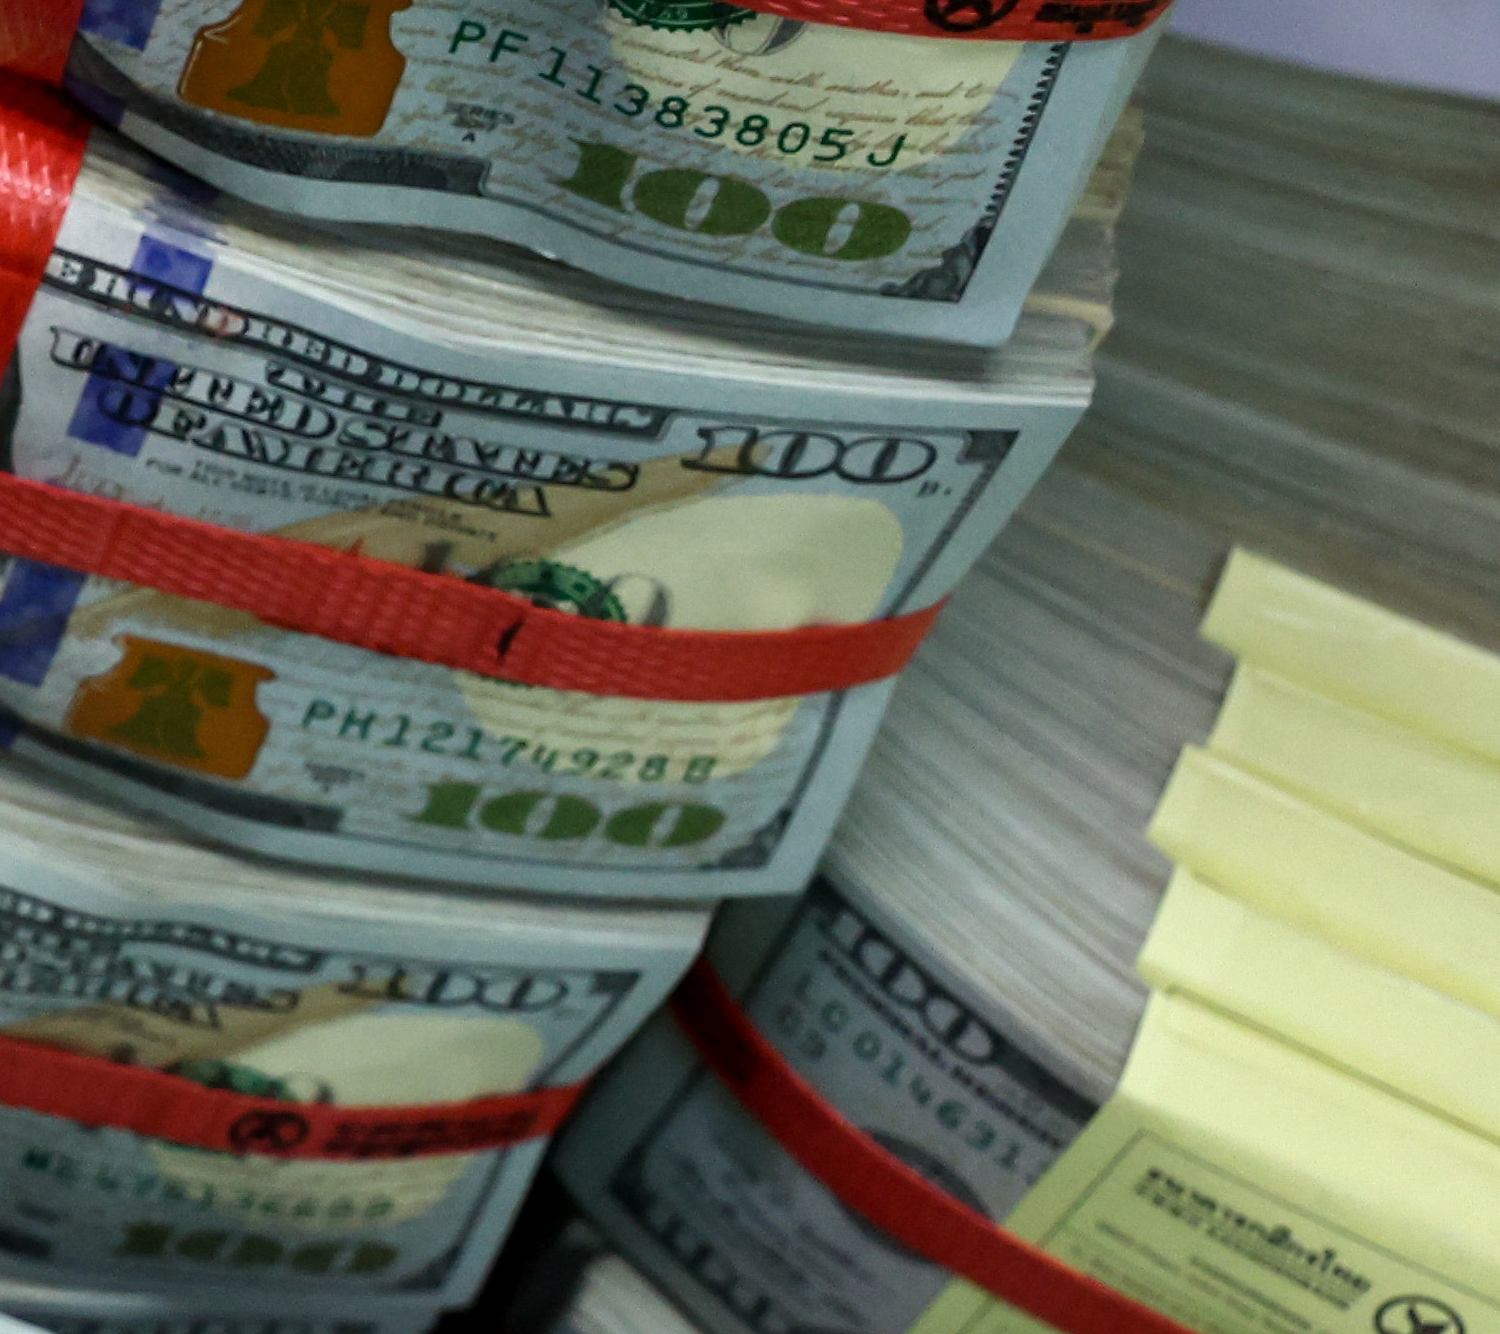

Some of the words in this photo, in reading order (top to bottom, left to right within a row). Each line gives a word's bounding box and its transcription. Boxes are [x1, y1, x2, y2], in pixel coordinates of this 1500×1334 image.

[448, 19, 907, 168] PF11383805J
[556, 137, 913, 261] 100
[682, 423, 938, 485] 100
[406, 781, 728, 846] 100
